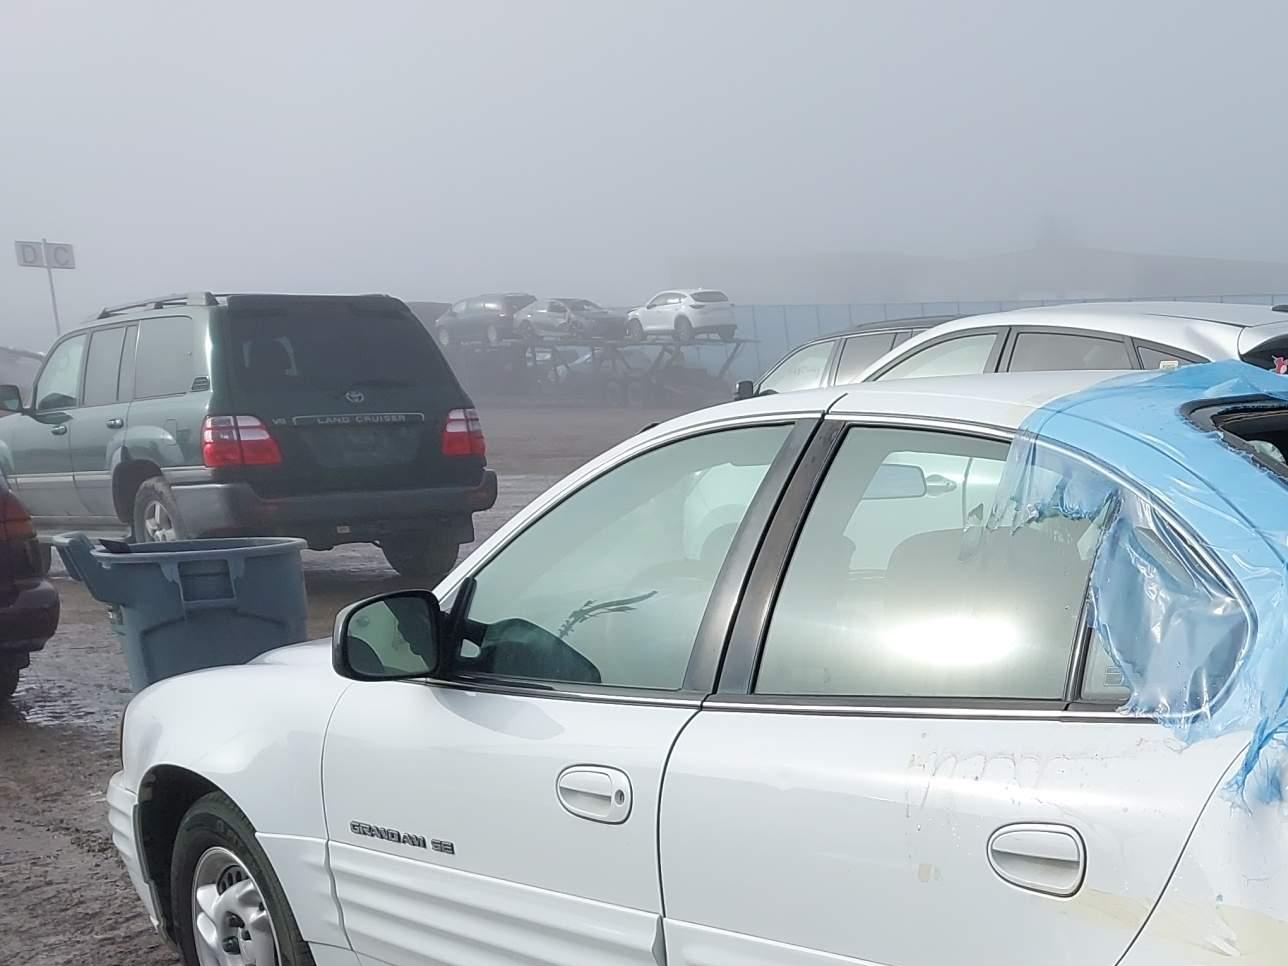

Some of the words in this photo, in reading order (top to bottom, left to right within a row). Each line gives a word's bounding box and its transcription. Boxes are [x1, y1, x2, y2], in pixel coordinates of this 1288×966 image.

[21, 244, 37, 264] D
[54, 246, 70, 266] C
[317, 416, 350, 425] LAND
[355, 414, 406, 424] CRUISER
[350, 820, 402, 844] GRAND
[402, 832, 428, 849] AM
